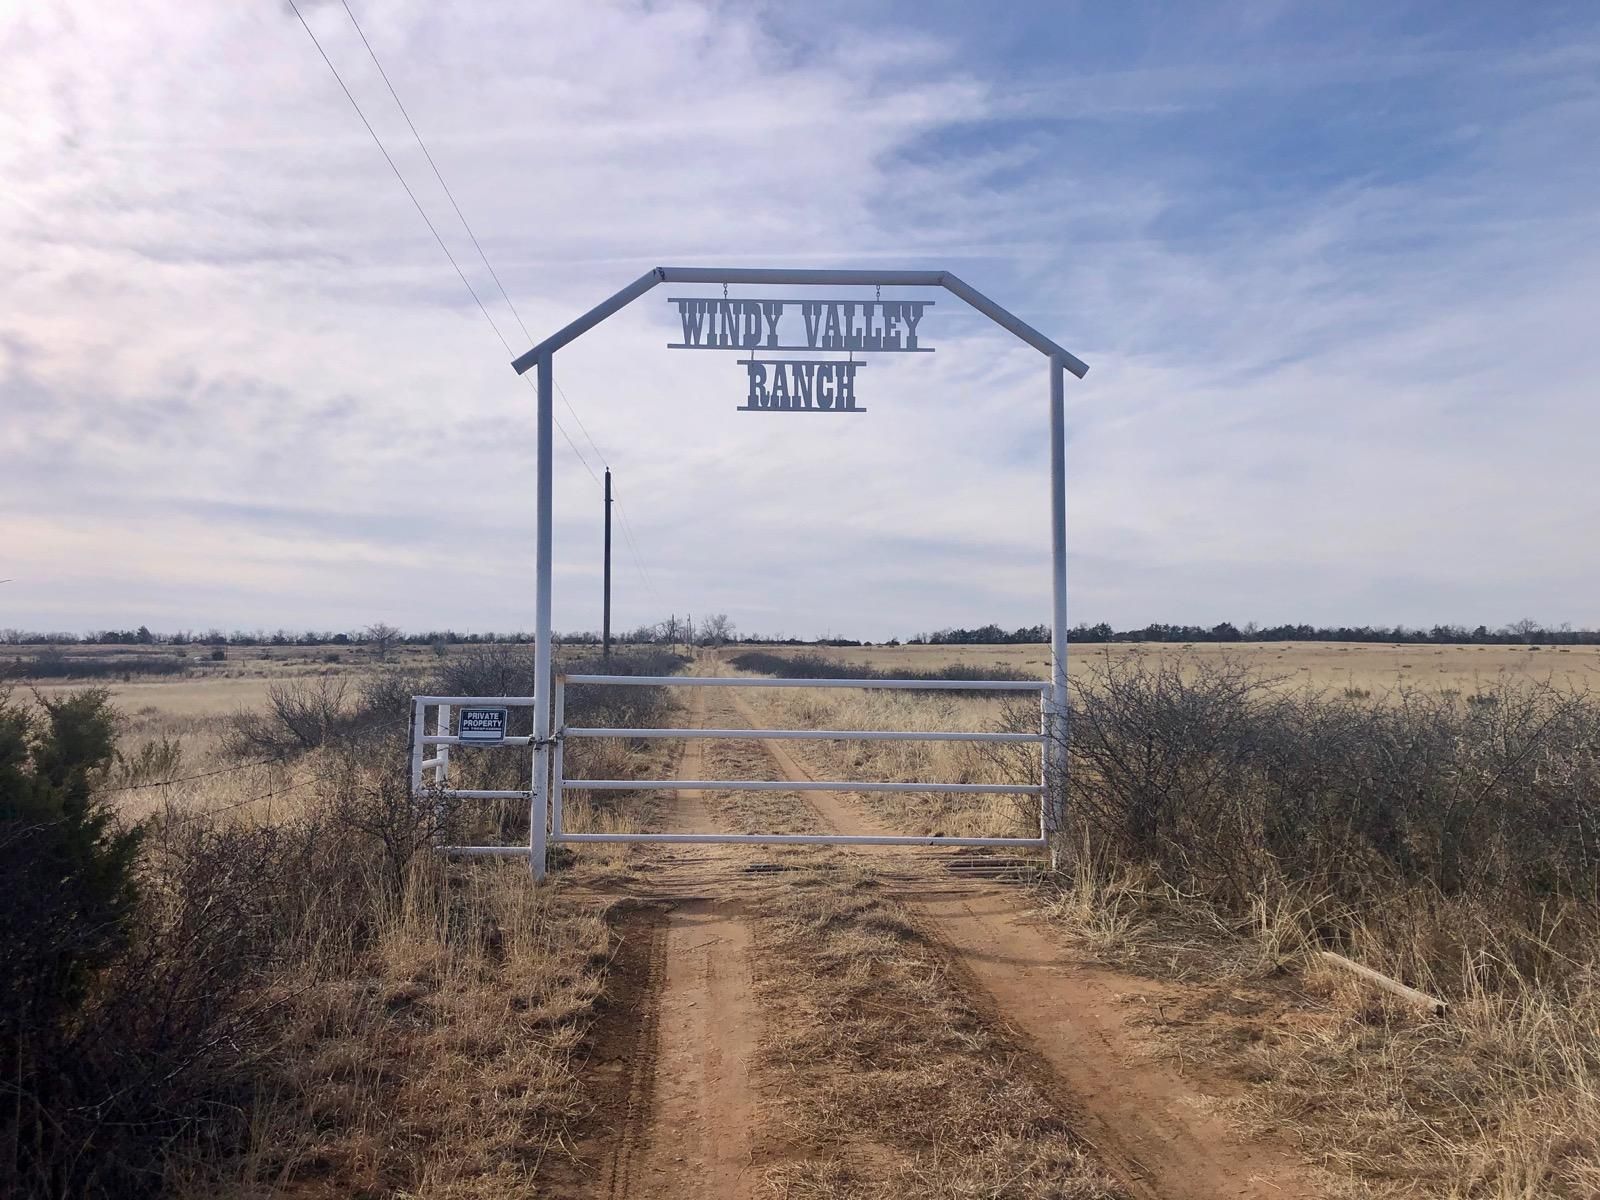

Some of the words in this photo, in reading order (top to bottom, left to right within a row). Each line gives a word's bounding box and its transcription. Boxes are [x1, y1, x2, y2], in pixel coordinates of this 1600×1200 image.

[678, 301, 783, 347] WINDY
[802, 303, 924, 349] VALLEY
[747, 363, 857, 409] RANCH
[467, 712, 499, 720] PRIVATE
